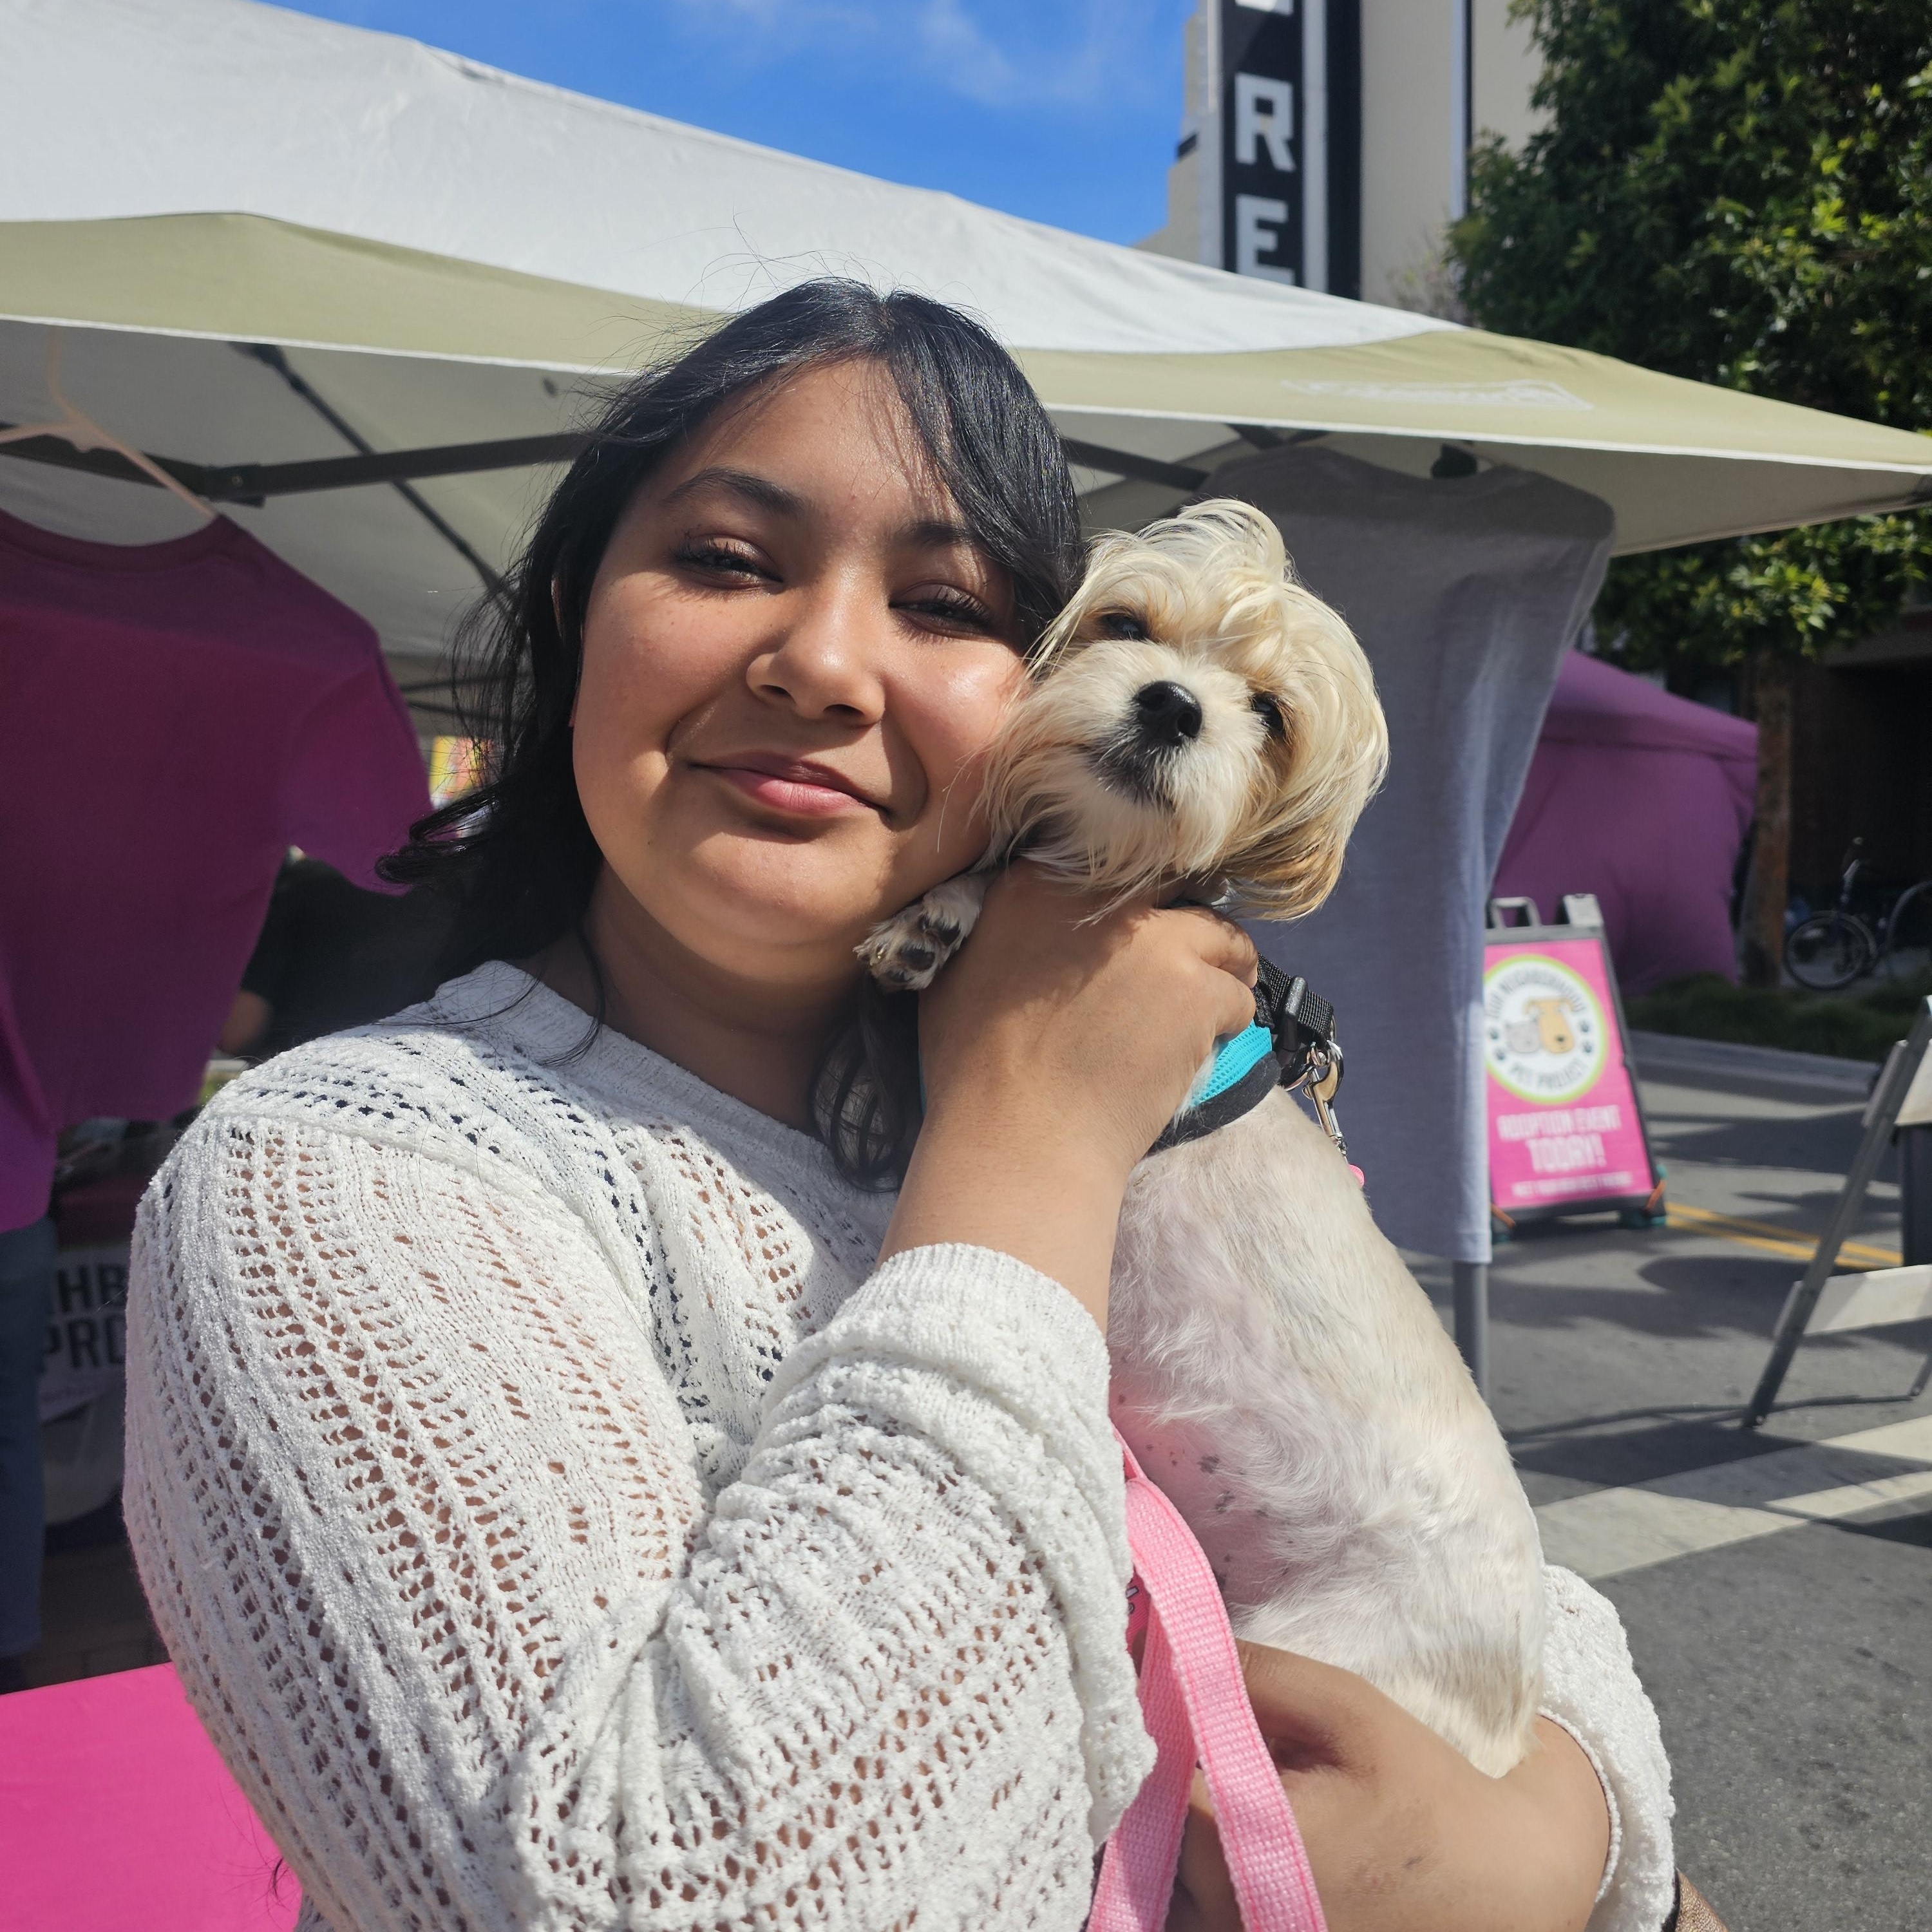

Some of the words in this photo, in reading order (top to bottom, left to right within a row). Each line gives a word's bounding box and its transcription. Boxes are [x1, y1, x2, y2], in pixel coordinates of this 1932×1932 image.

[1235, 0, 1296, 287] RE
[1497, 1110, 1571, 1141] ADOPTION
[1575, 1104, 1622, 1132] EVENT
[1526, 1132, 1607, 1173] TODAY!
